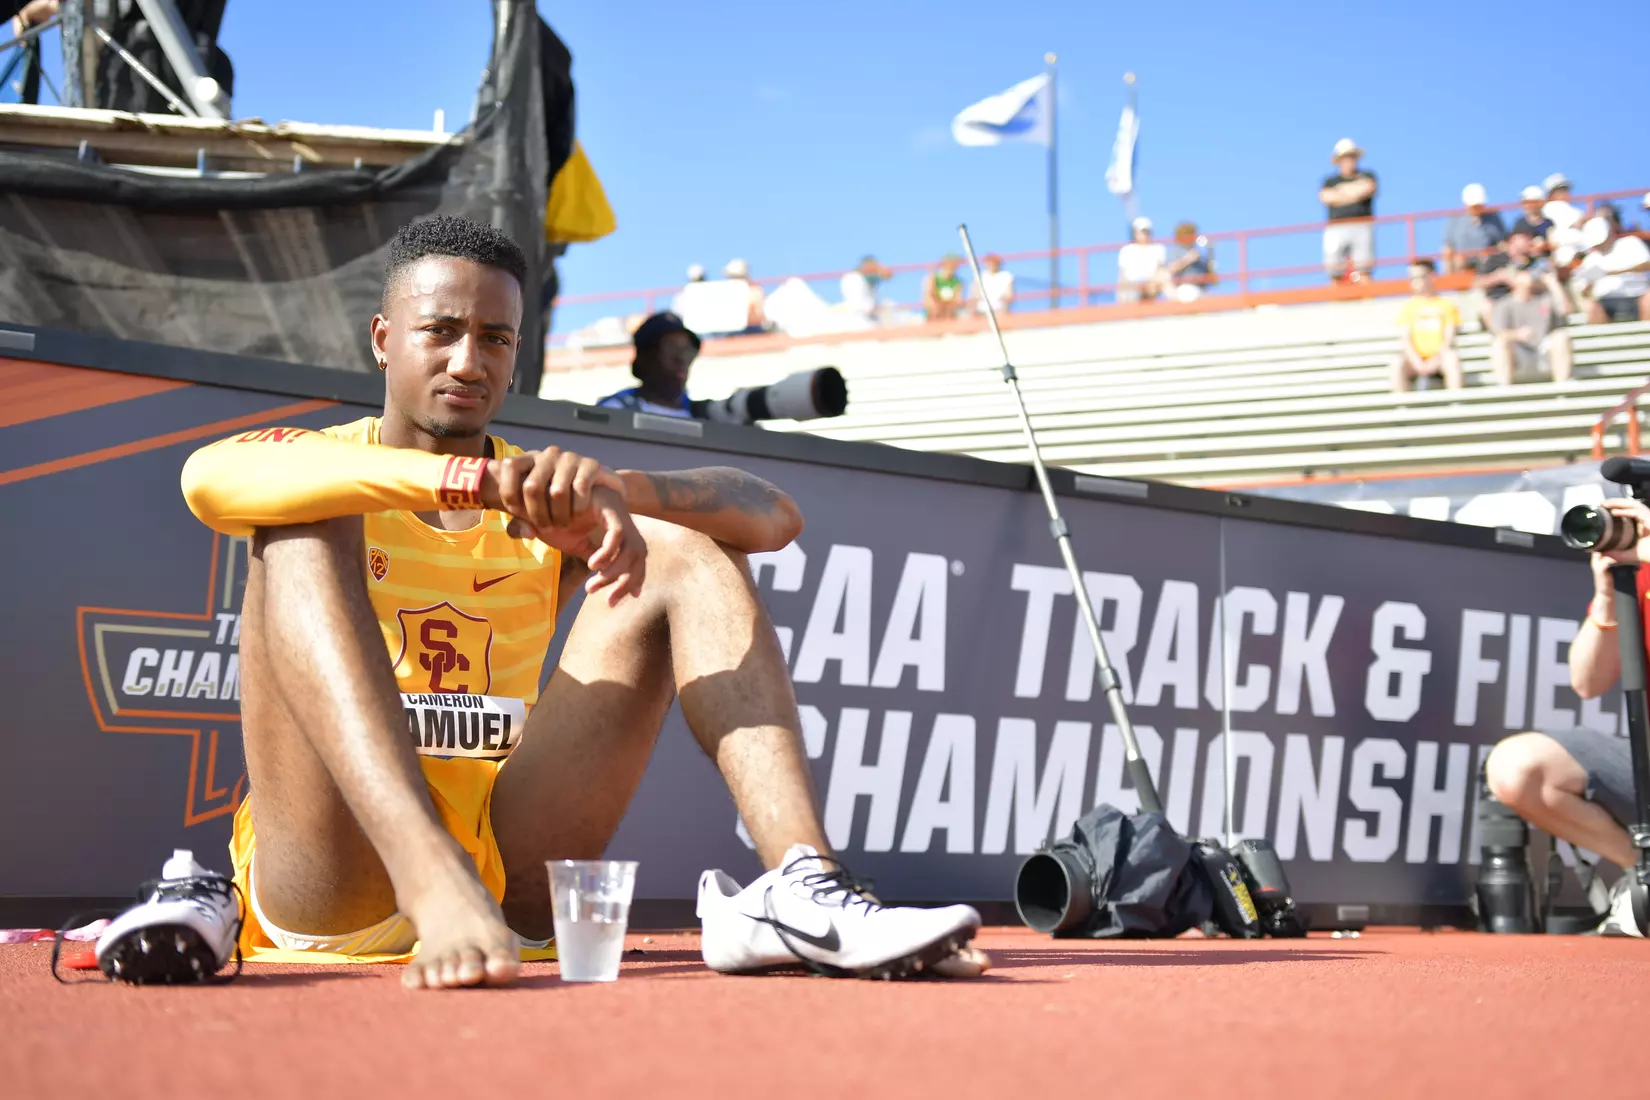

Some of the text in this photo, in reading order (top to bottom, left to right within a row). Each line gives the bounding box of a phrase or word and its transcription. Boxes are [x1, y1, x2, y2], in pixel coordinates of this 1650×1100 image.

[1010, 563, 1345, 717] TRACK
[1364, 600, 1432, 723] &
[1454, 608, 1630, 738] FIE
[407, 693, 485, 709] CAMERON
